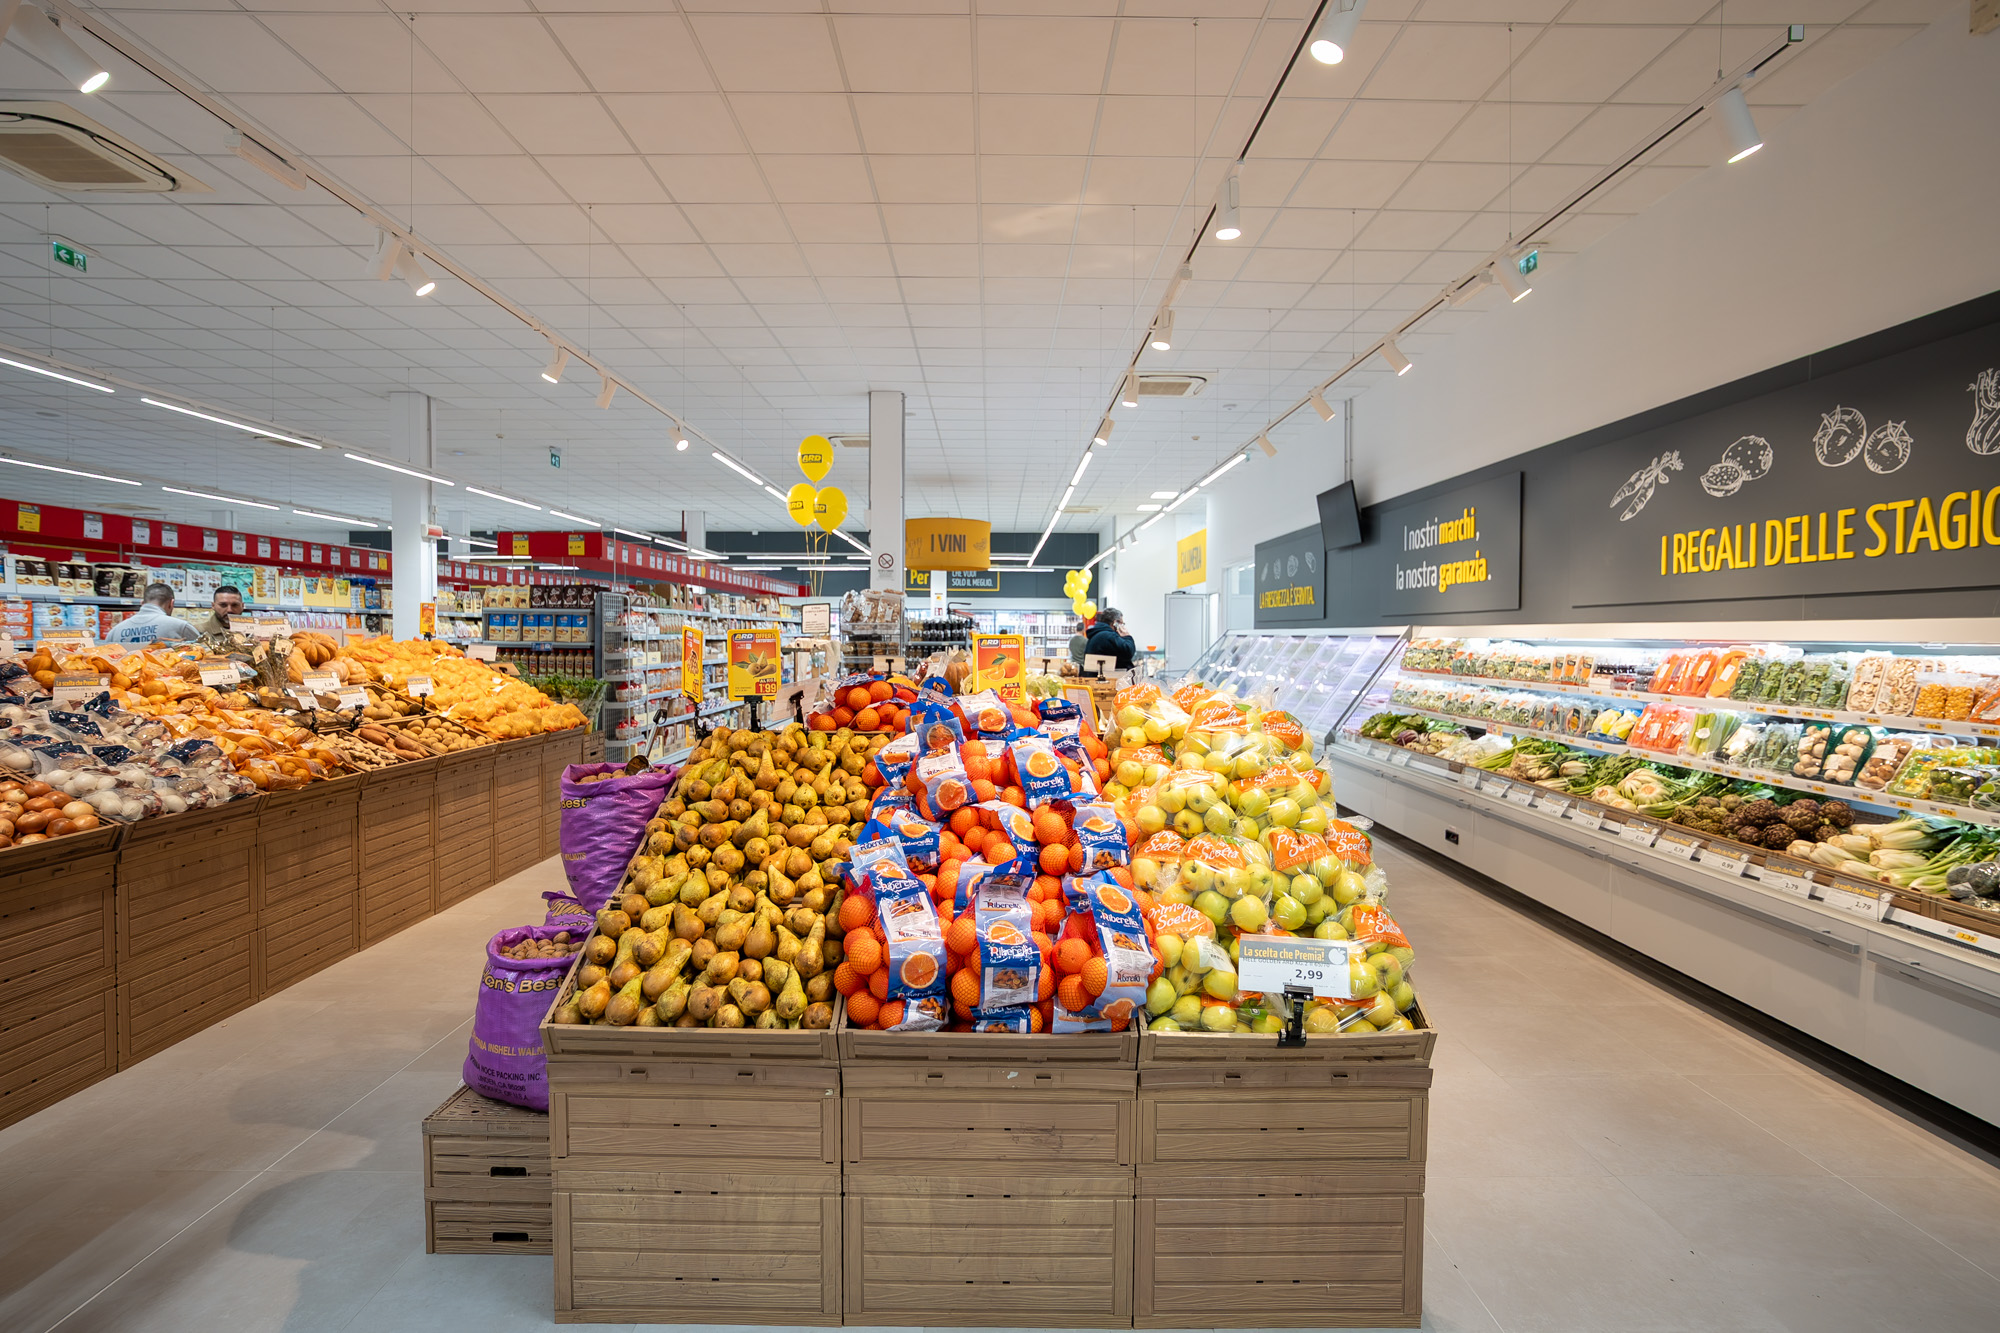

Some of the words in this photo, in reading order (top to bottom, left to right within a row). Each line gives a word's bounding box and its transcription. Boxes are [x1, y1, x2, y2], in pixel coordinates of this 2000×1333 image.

[1404, 525, 1407, 551] I
[1409, 517, 1438, 550] nostri
[1661, 535, 1667, 575] I
[1673, 522, 1757, 574] REGALI
[1764, 508, 1857, 566] DELLE
[931, 534, 934, 552] I
[938, 534, 966, 552] VINI
[910, 569, 929, 585] Per
[952, 578, 965, 587] SOLO
[1396, 563, 1404, 590] la
[1405, 560, 1437, 589] nostra
[121, 624, 158, 639] CONVIENE
[1129, 683, 1157, 701] Scelta
[1053, 737, 1075, 750] berella
[1030, 777, 1065, 790] Riberella
[860, 837, 891, 851] Riberella
[1087, 832, 1123, 842] Riberella
[1854, 901, 1872, 911] 1,79
[1101, 911, 1139, 926] Riberella
[1156, 905, 1200, 930] Scelta
[989, 944, 1033, 958] Riberella
[1244, 946, 1253, 957] La
[1254, 947, 1278, 958] scelta
[1279, 948, 1293, 959] che
[1295, 949, 1325, 962] Premia!
[1295, 969, 1323, 980] 2,99
[518, 974, 562, 993] Best
[488, 1042, 516, 1057] INSHELL
[481, 1065, 496, 1078] NOCE
[528, 1073, 543, 1081] INC.
